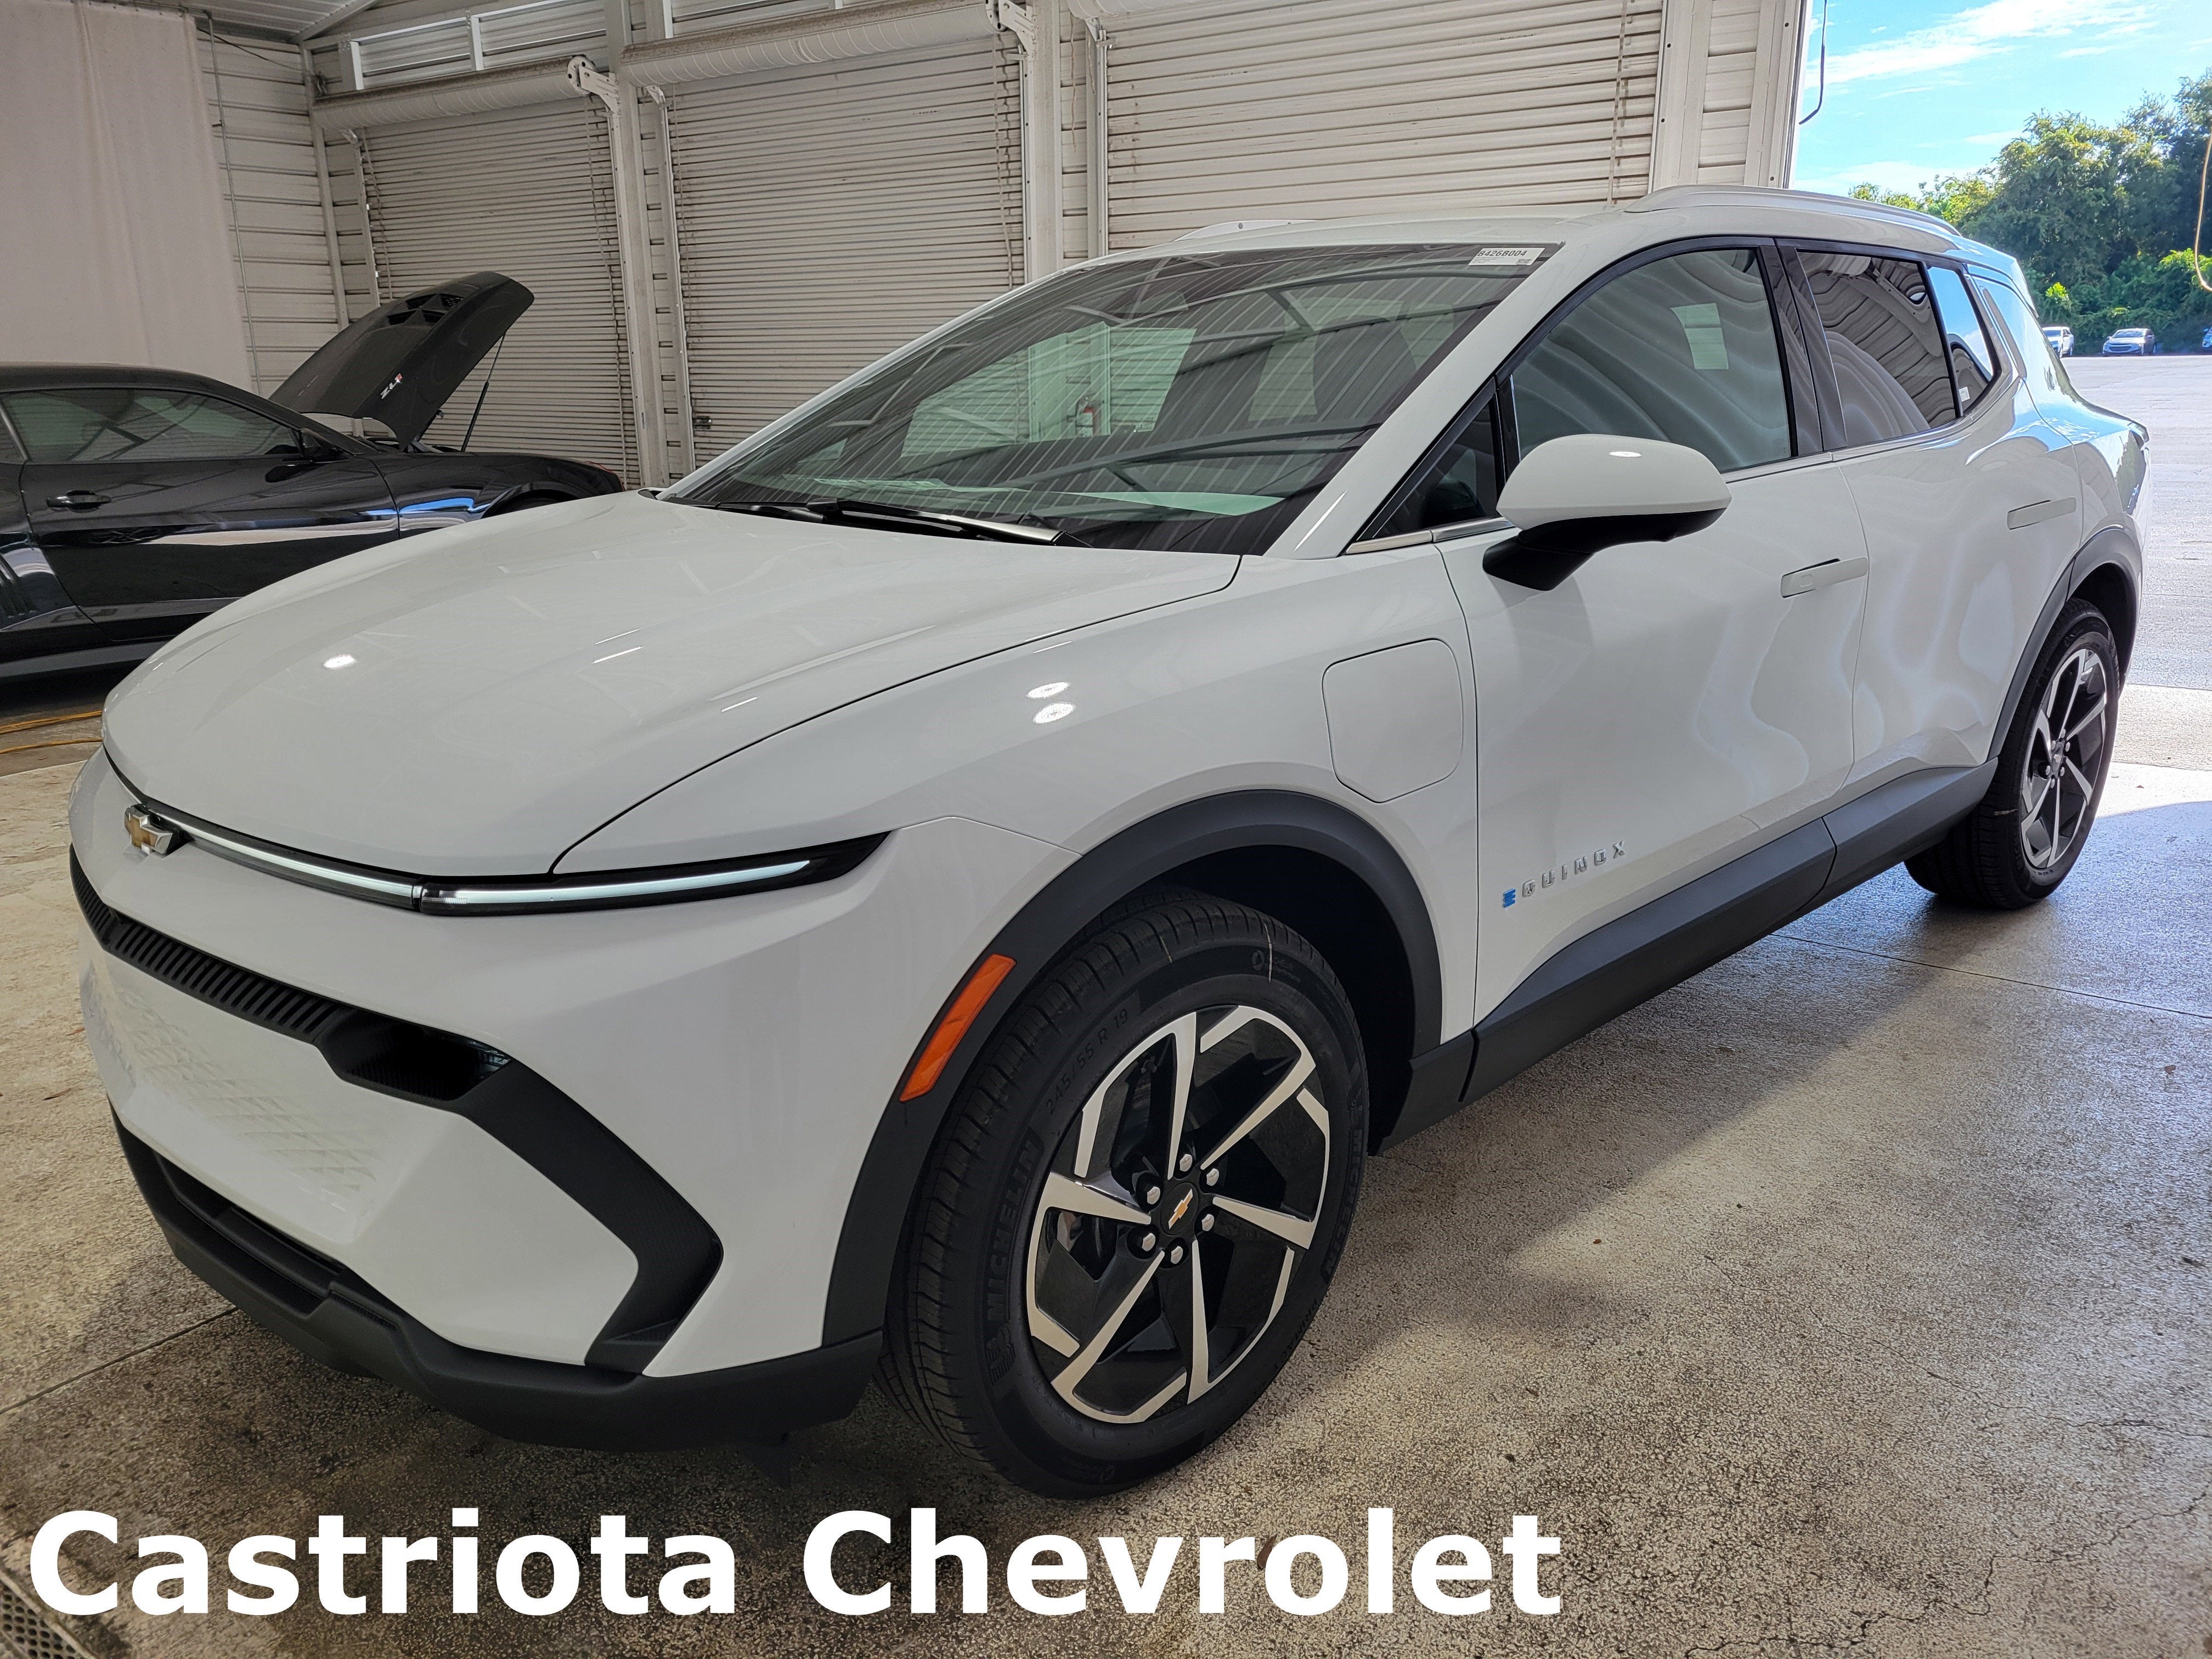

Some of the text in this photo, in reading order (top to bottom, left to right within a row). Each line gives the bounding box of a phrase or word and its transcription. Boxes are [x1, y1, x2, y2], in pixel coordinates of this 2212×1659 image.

[380, 373, 403, 399] ZL1
[1502, 839, 1626, 909] EQUINOX
[1045, 1008, 1127, 1116] 245/55 R 19
[986, 1138, 1042, 1322] MICHELIN
